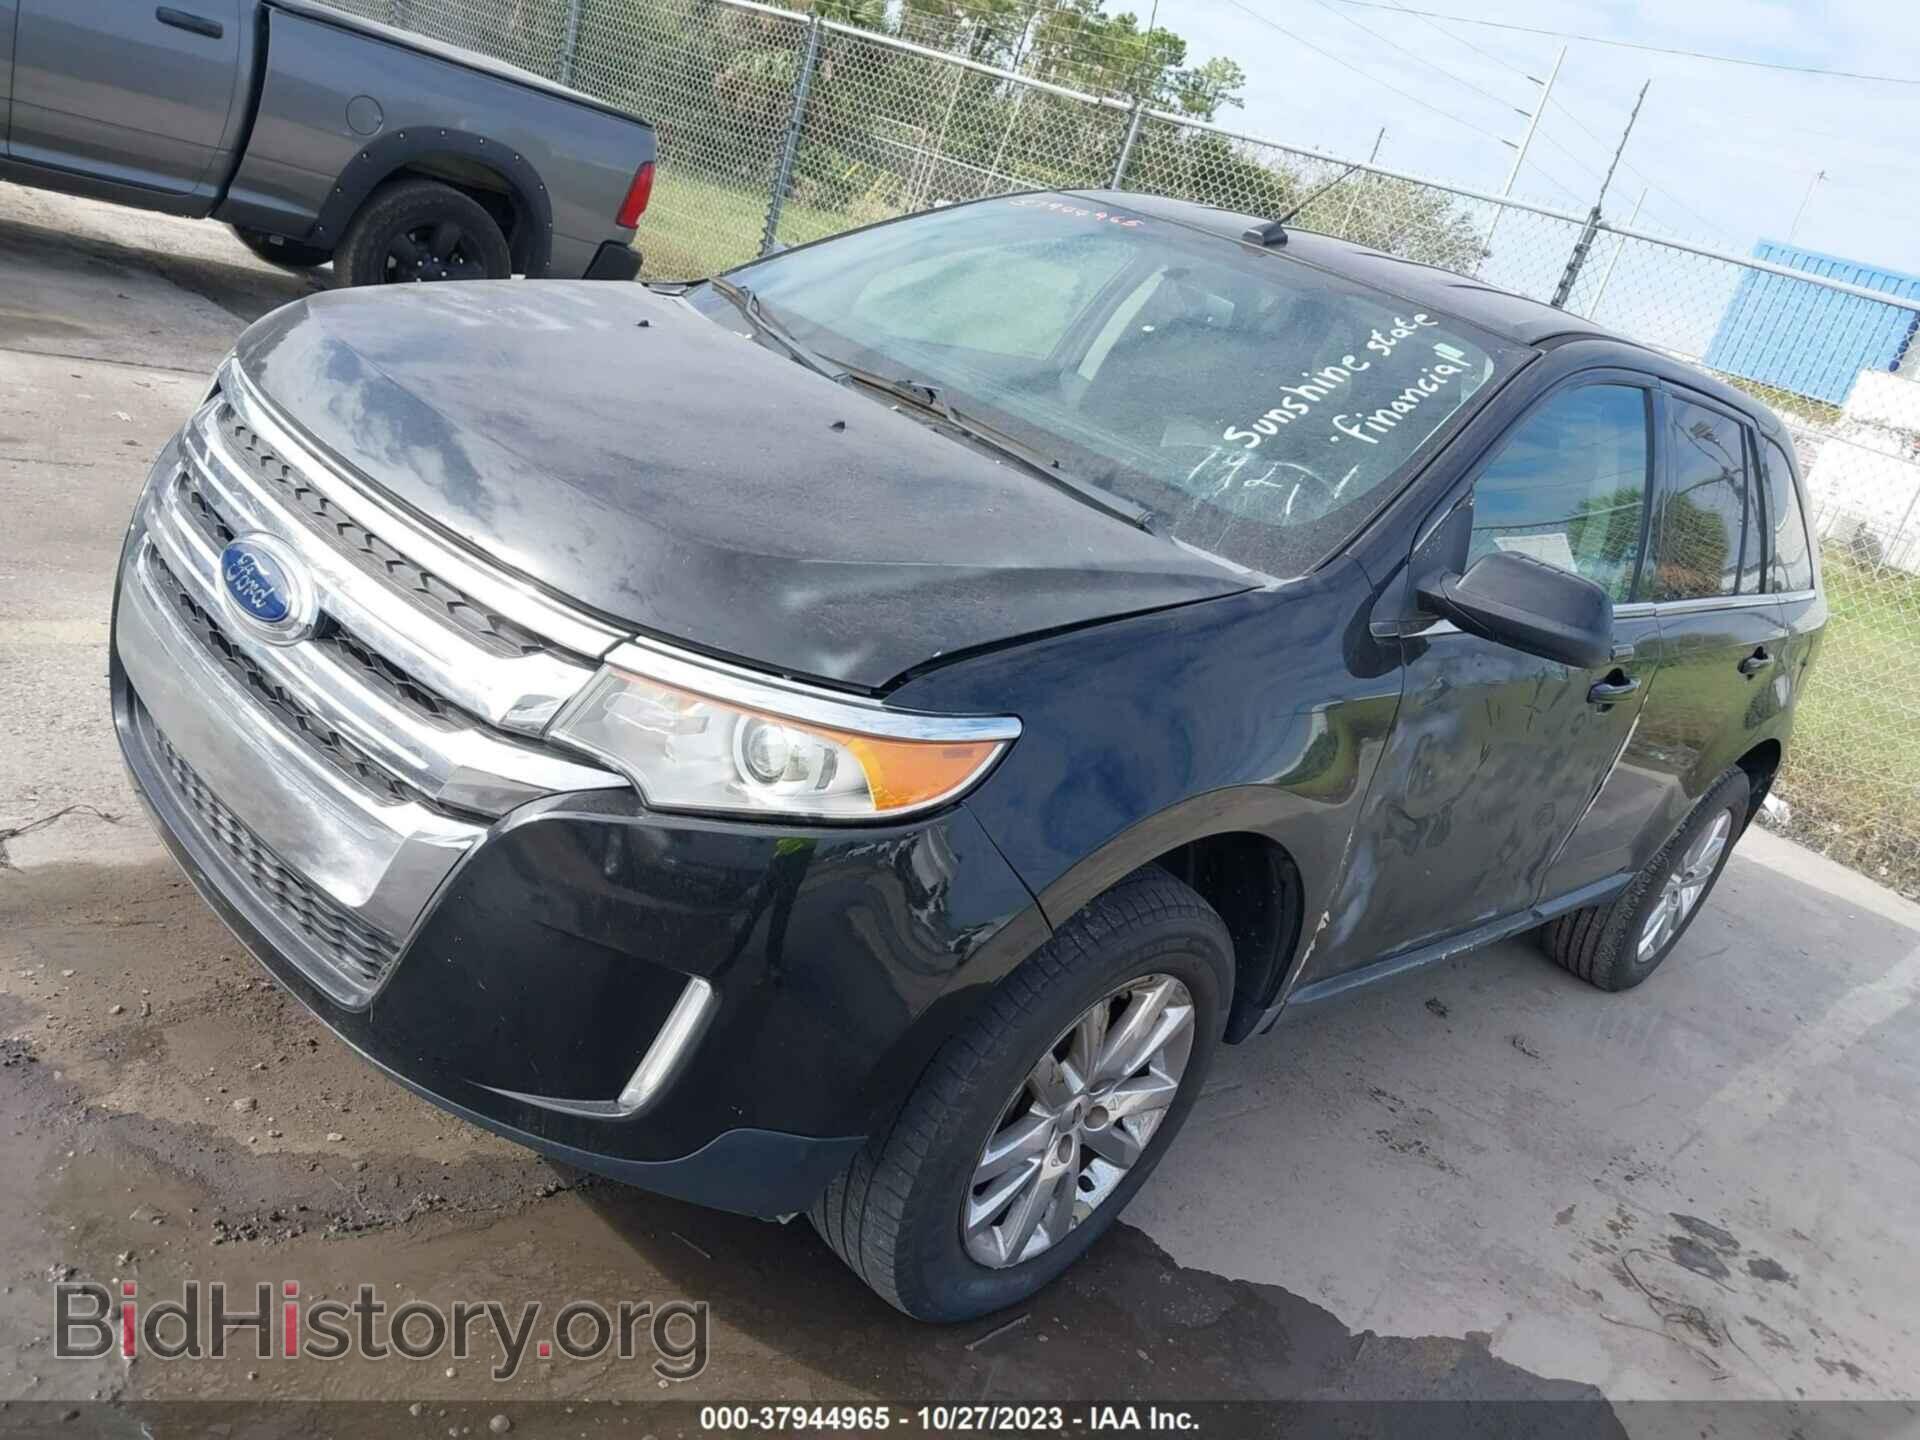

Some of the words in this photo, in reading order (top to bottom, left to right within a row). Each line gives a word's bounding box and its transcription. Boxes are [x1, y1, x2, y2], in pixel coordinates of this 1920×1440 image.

[1223, 354, 1370, 449] Sunshine
[1366, 313, 1439, 357] state
[227, 552, 275, 608] Ford
